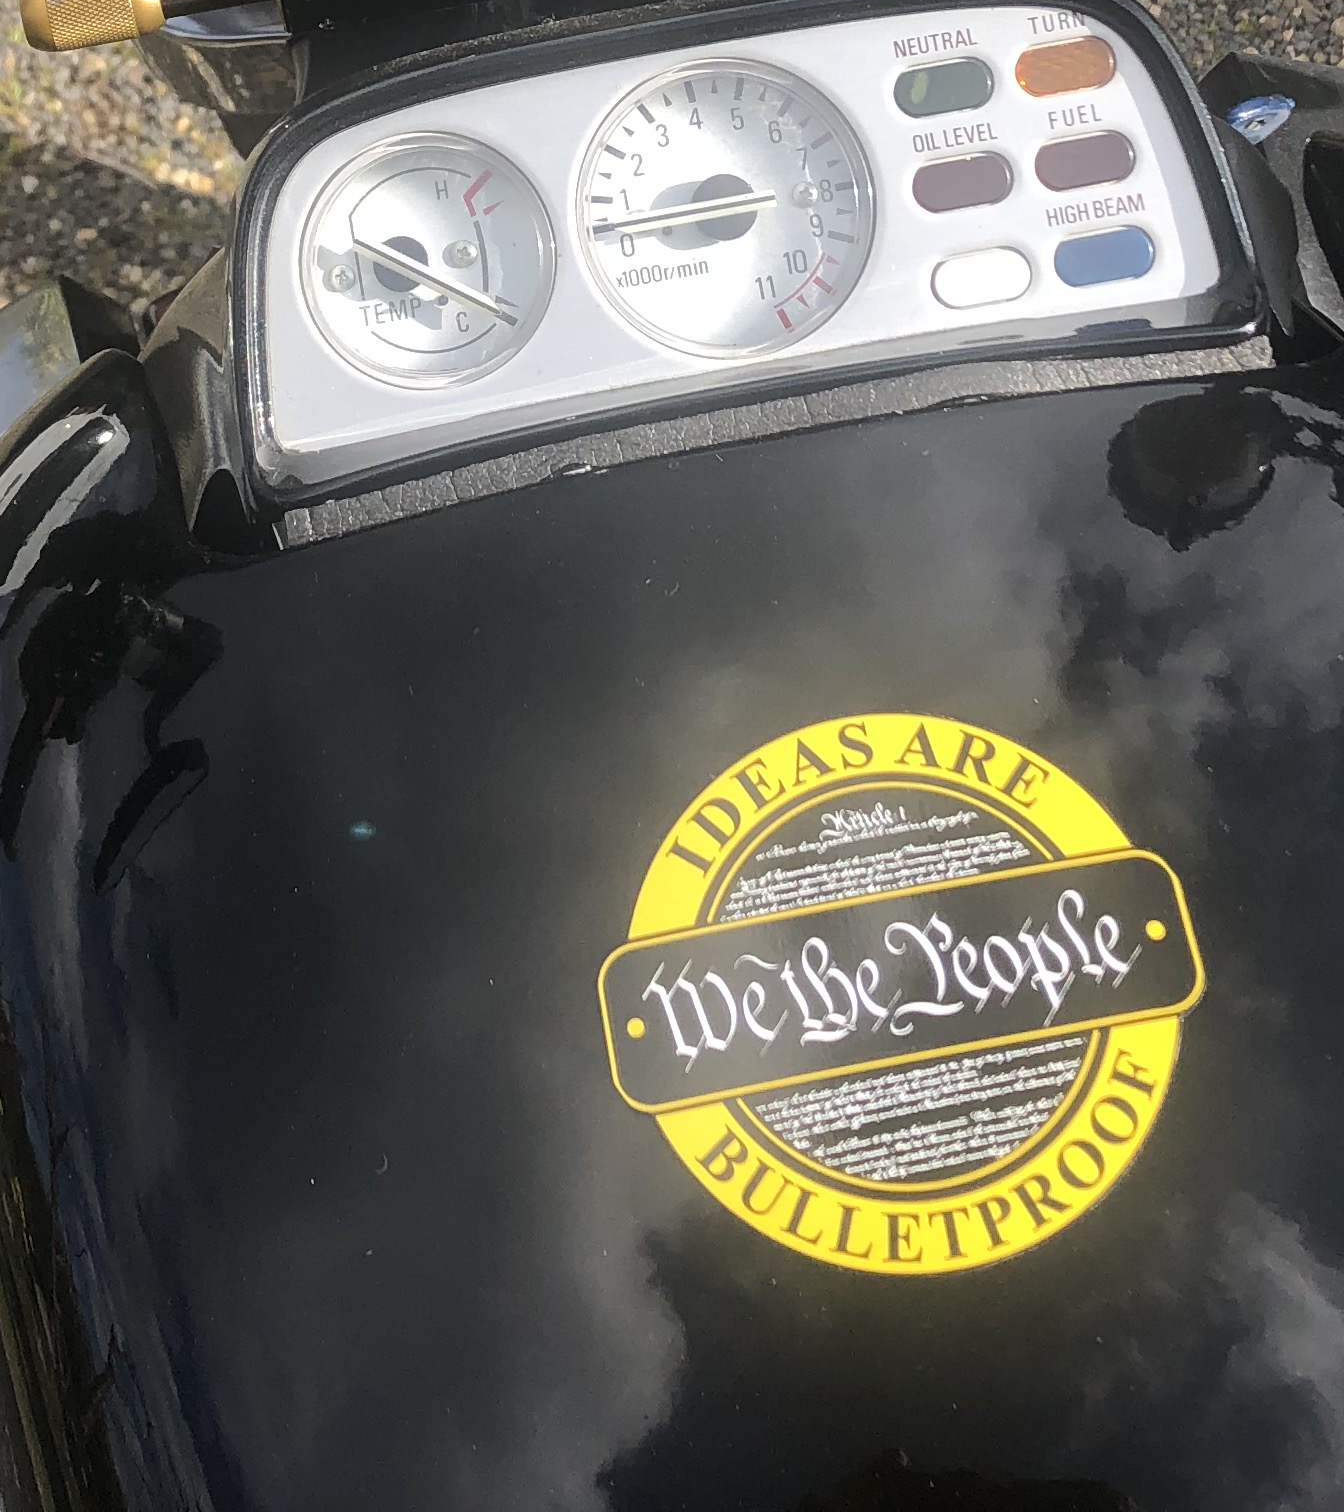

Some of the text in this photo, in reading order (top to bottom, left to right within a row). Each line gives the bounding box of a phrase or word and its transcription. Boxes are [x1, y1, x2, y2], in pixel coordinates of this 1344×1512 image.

[1027, 11, 1087, 35] TURN
[893, 28, 978, 58] NEUTRAL
[689, 107, 704, 130] 4
[730, 107, 745, 131] 5
[1048, 103, 1103, 130] FUEL
[655, 124, 670, 148] 3
[768, 120, 783, 144] 6
[912, 122, 998, 153] OIL LEVEL
[630, 153, 645, 177] 2
[796, 146, 809, 171] 7
[434, 180, 449, 200] H
[619, 189, 630, 211] 1
[819, 179, 834, 203] 8
[1046, 192, 1146, 227] HIGH BEAM
[809, 214, 824, 238] 9
[619, 233, 635, 258] 0
[783, 249, 808, 275] 10
[755, 275, 777, 300] 11
[358, 297, 422, 327] TEMP
[455, 311, 470, 333] C
[665, 721, 875, 878] IDEAS
[894, 721, 1050, 809] ARE
[642, 889, 1142, 1073] We the People
[695, 1048, 1159, 1264] BULLETPROOF
